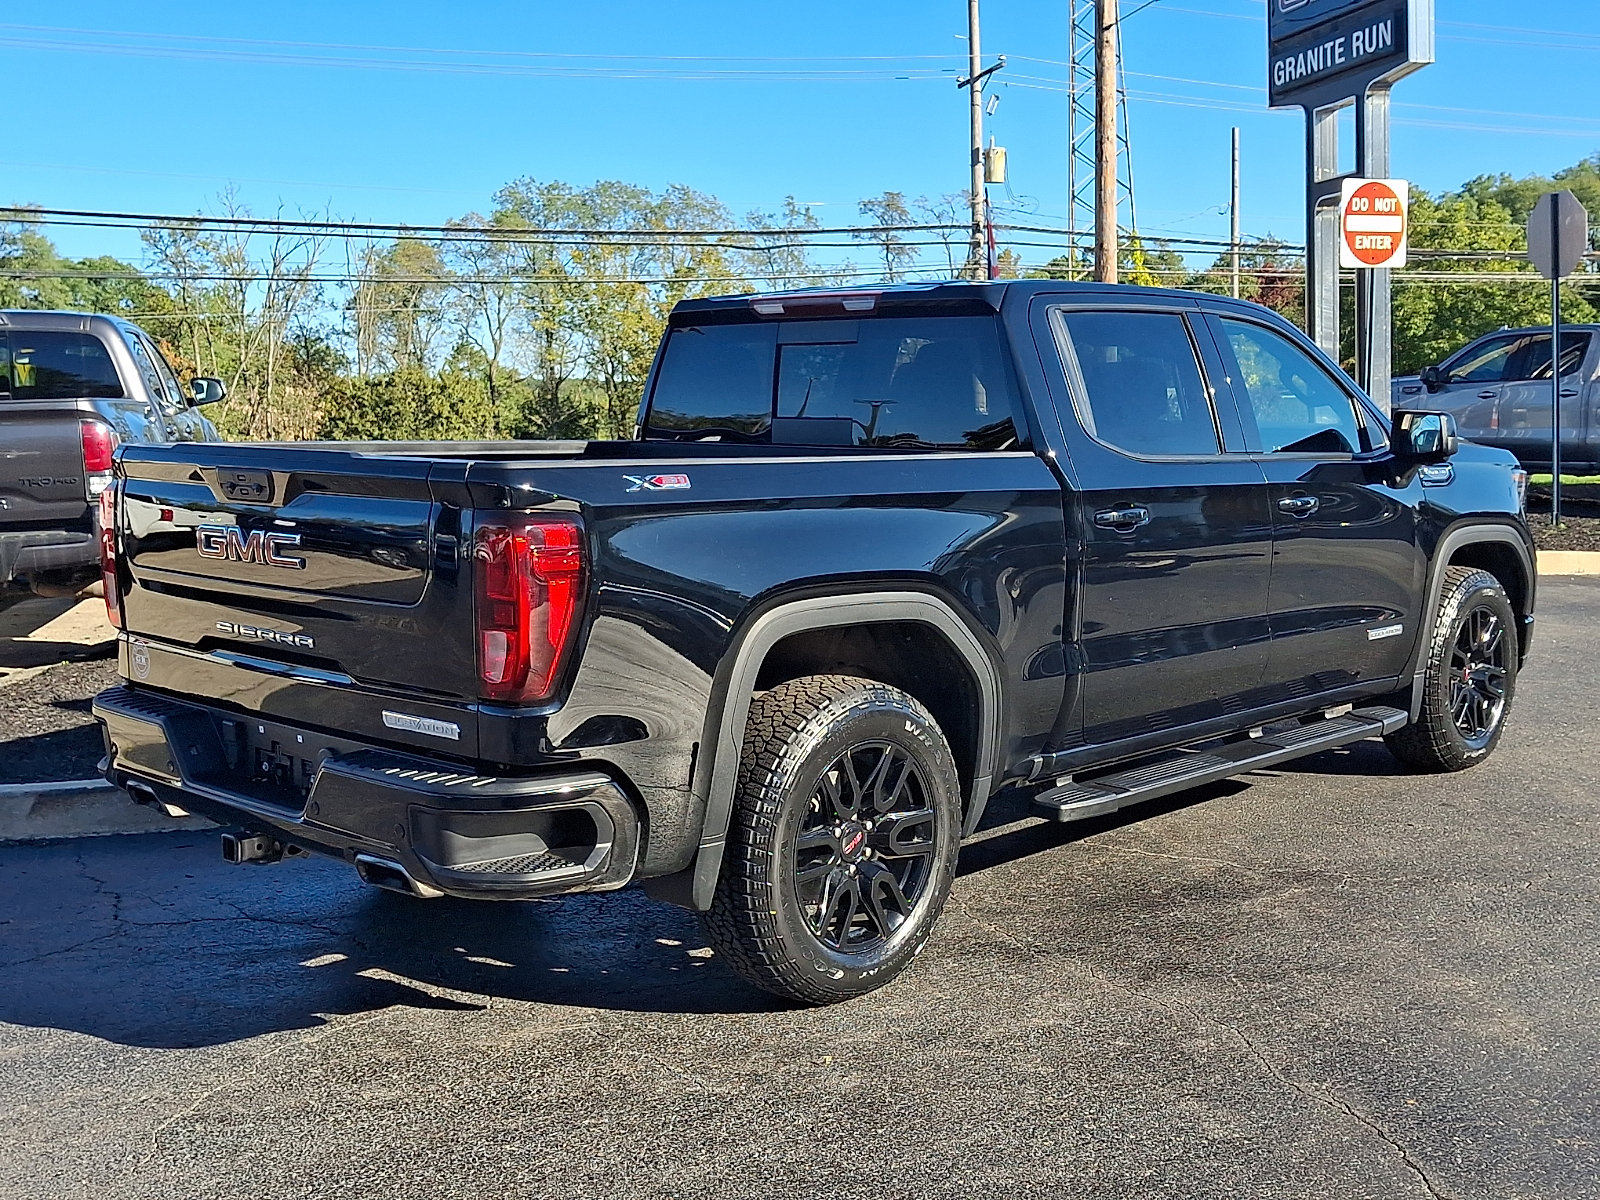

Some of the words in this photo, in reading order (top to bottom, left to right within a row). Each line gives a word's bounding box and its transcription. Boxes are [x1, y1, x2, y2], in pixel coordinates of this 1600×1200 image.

[1273, 36, 1346, 86] GRANITE
[1352, 19, 1392, 58] RUN
[1351, 197, 1369, 212] DO
[1374, 197, 1398, 212] NOT
[1355, 235, 1392, 250] ENTER
[196, 524, 306, 570] GMC
[216, 621, 315, 649] SIERRA
[384, 713, 457, 736] ELEVATION
